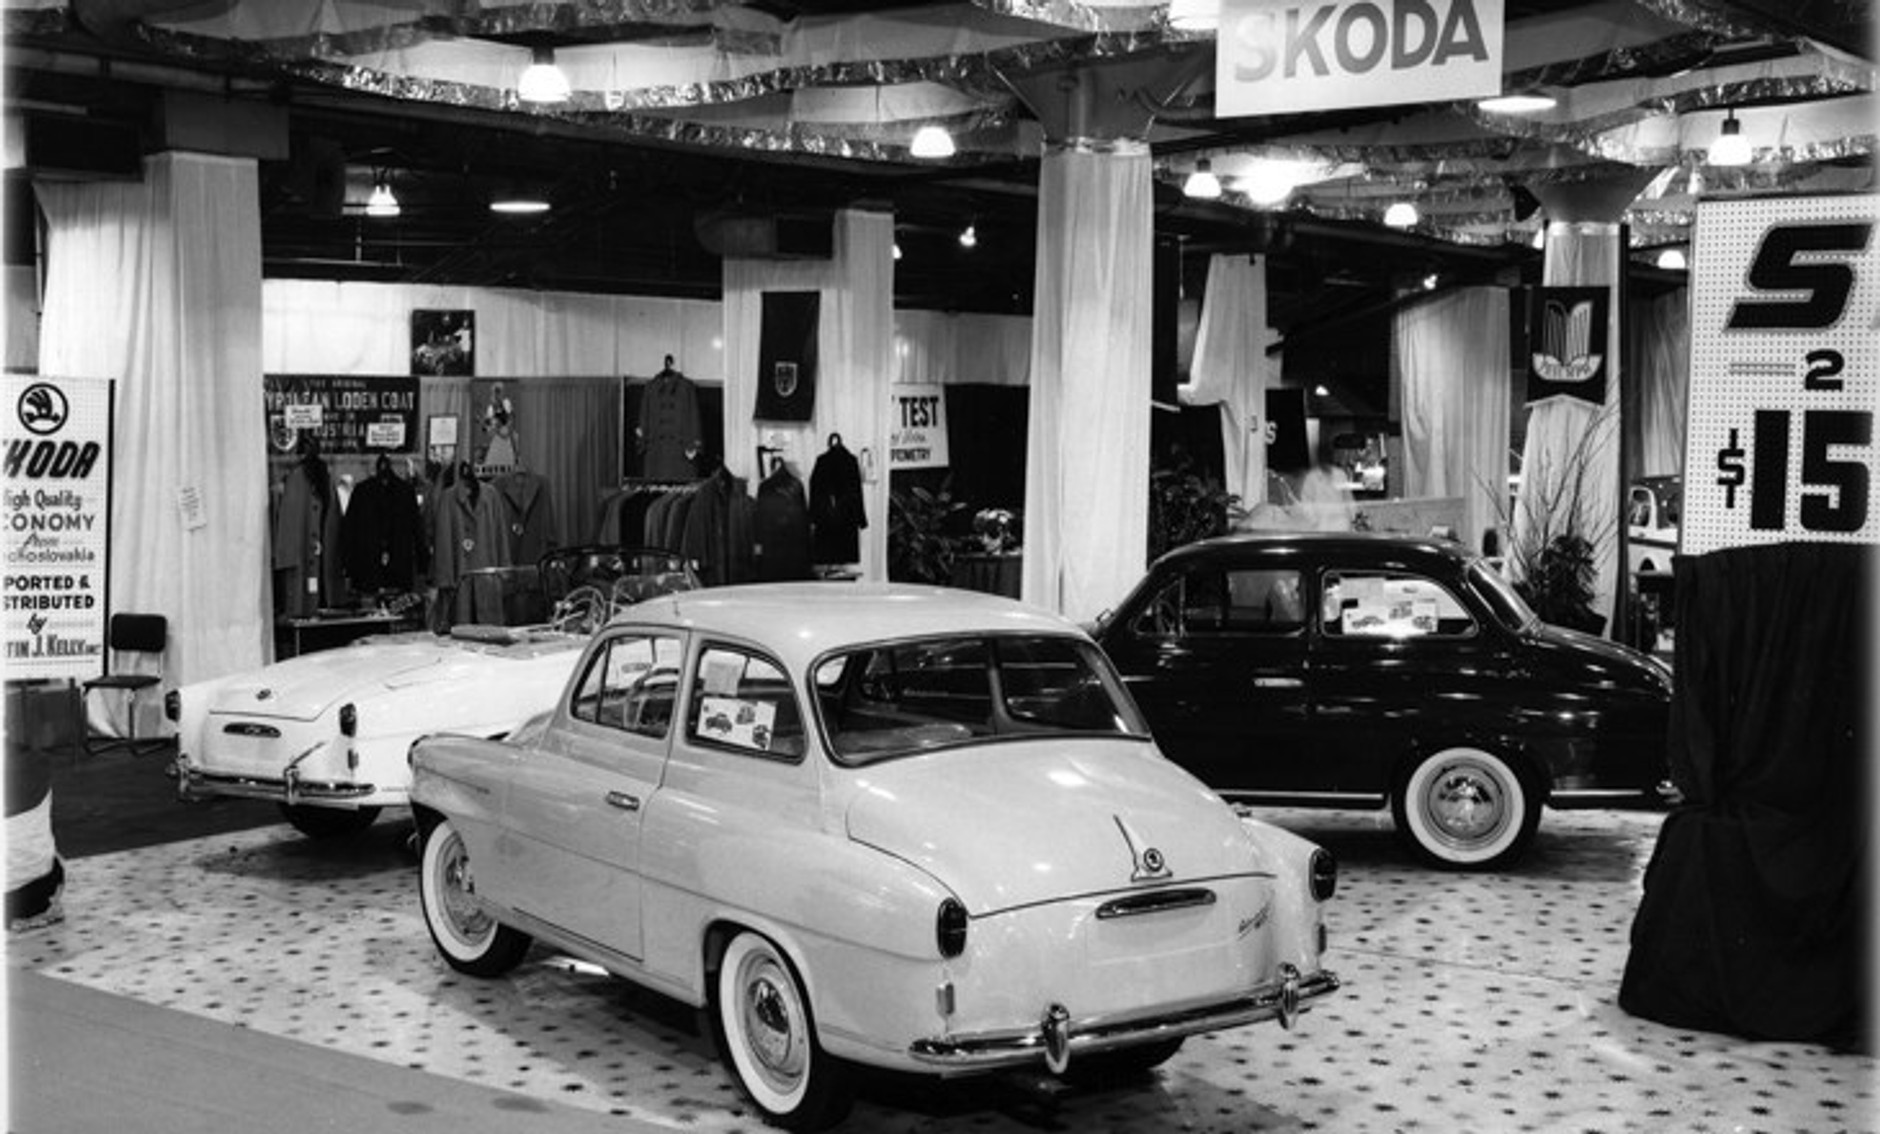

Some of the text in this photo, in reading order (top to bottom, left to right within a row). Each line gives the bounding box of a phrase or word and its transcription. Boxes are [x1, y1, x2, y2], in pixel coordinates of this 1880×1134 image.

[1234, 0, 1489, 82] SKODA
[334, 391, 378, 410] LODEN
[381, 391, 415, 410] COAT
[899, 396, 939, 428] TEST
[3, 439, 101, 479] KODA
[4, 512, 95, 531] ONOMY
[4, 574, 74, 591] PORTED
